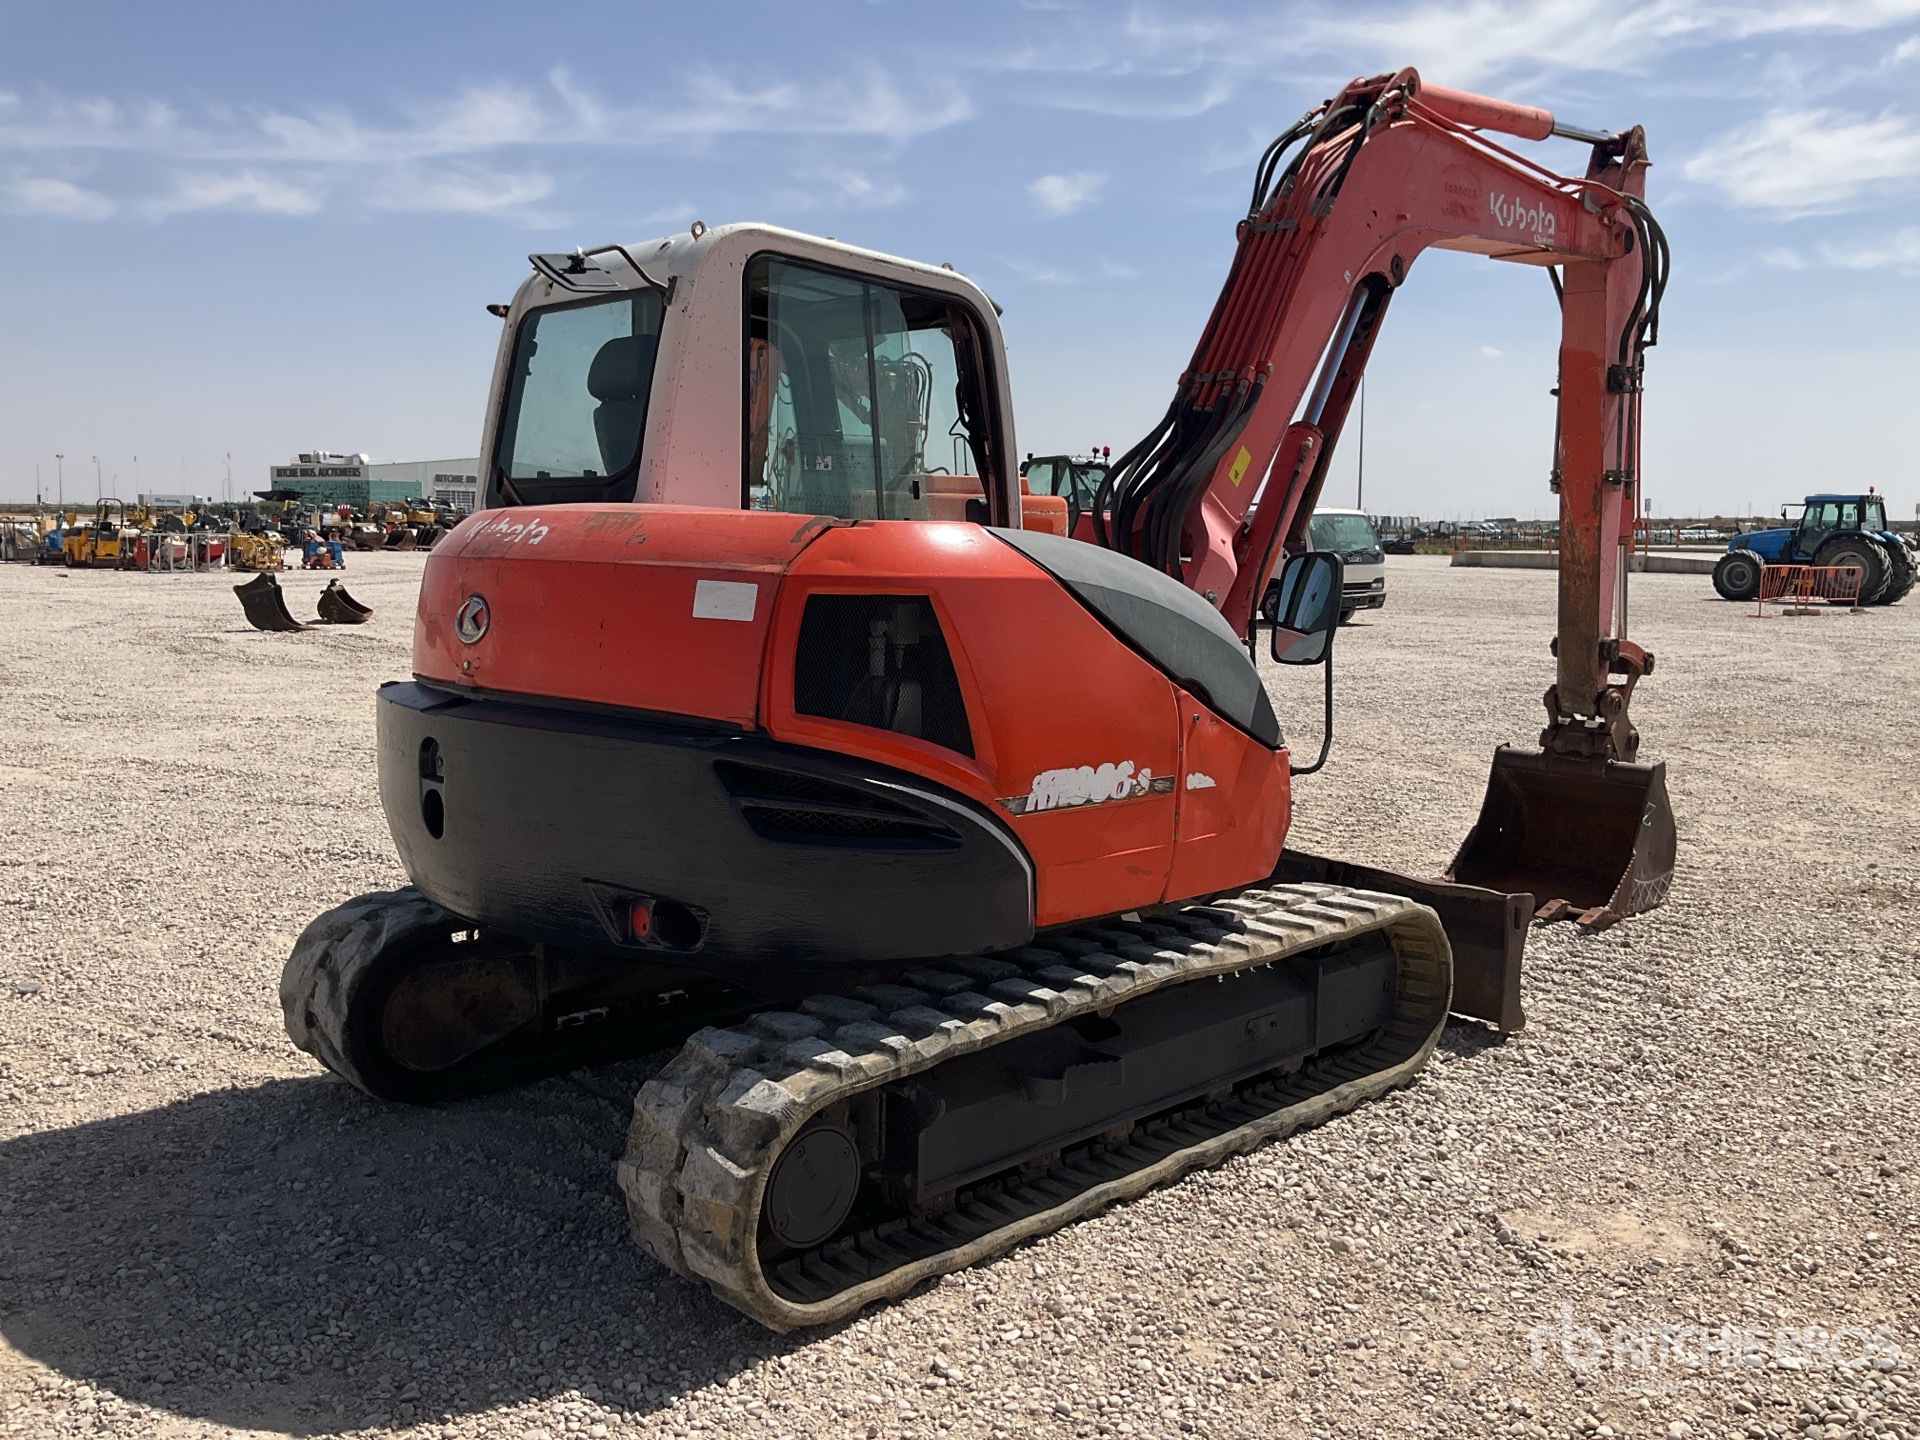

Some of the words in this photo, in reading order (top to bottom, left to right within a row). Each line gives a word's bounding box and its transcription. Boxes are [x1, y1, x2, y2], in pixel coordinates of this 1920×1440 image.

[1490, 192, 1555, 235] Kubota
[276, 468, 299, 477] RITCHIE
[318, 467, 361, 477] AUCTIONEERS
[435, 474, 465, 483] RITCHIE
